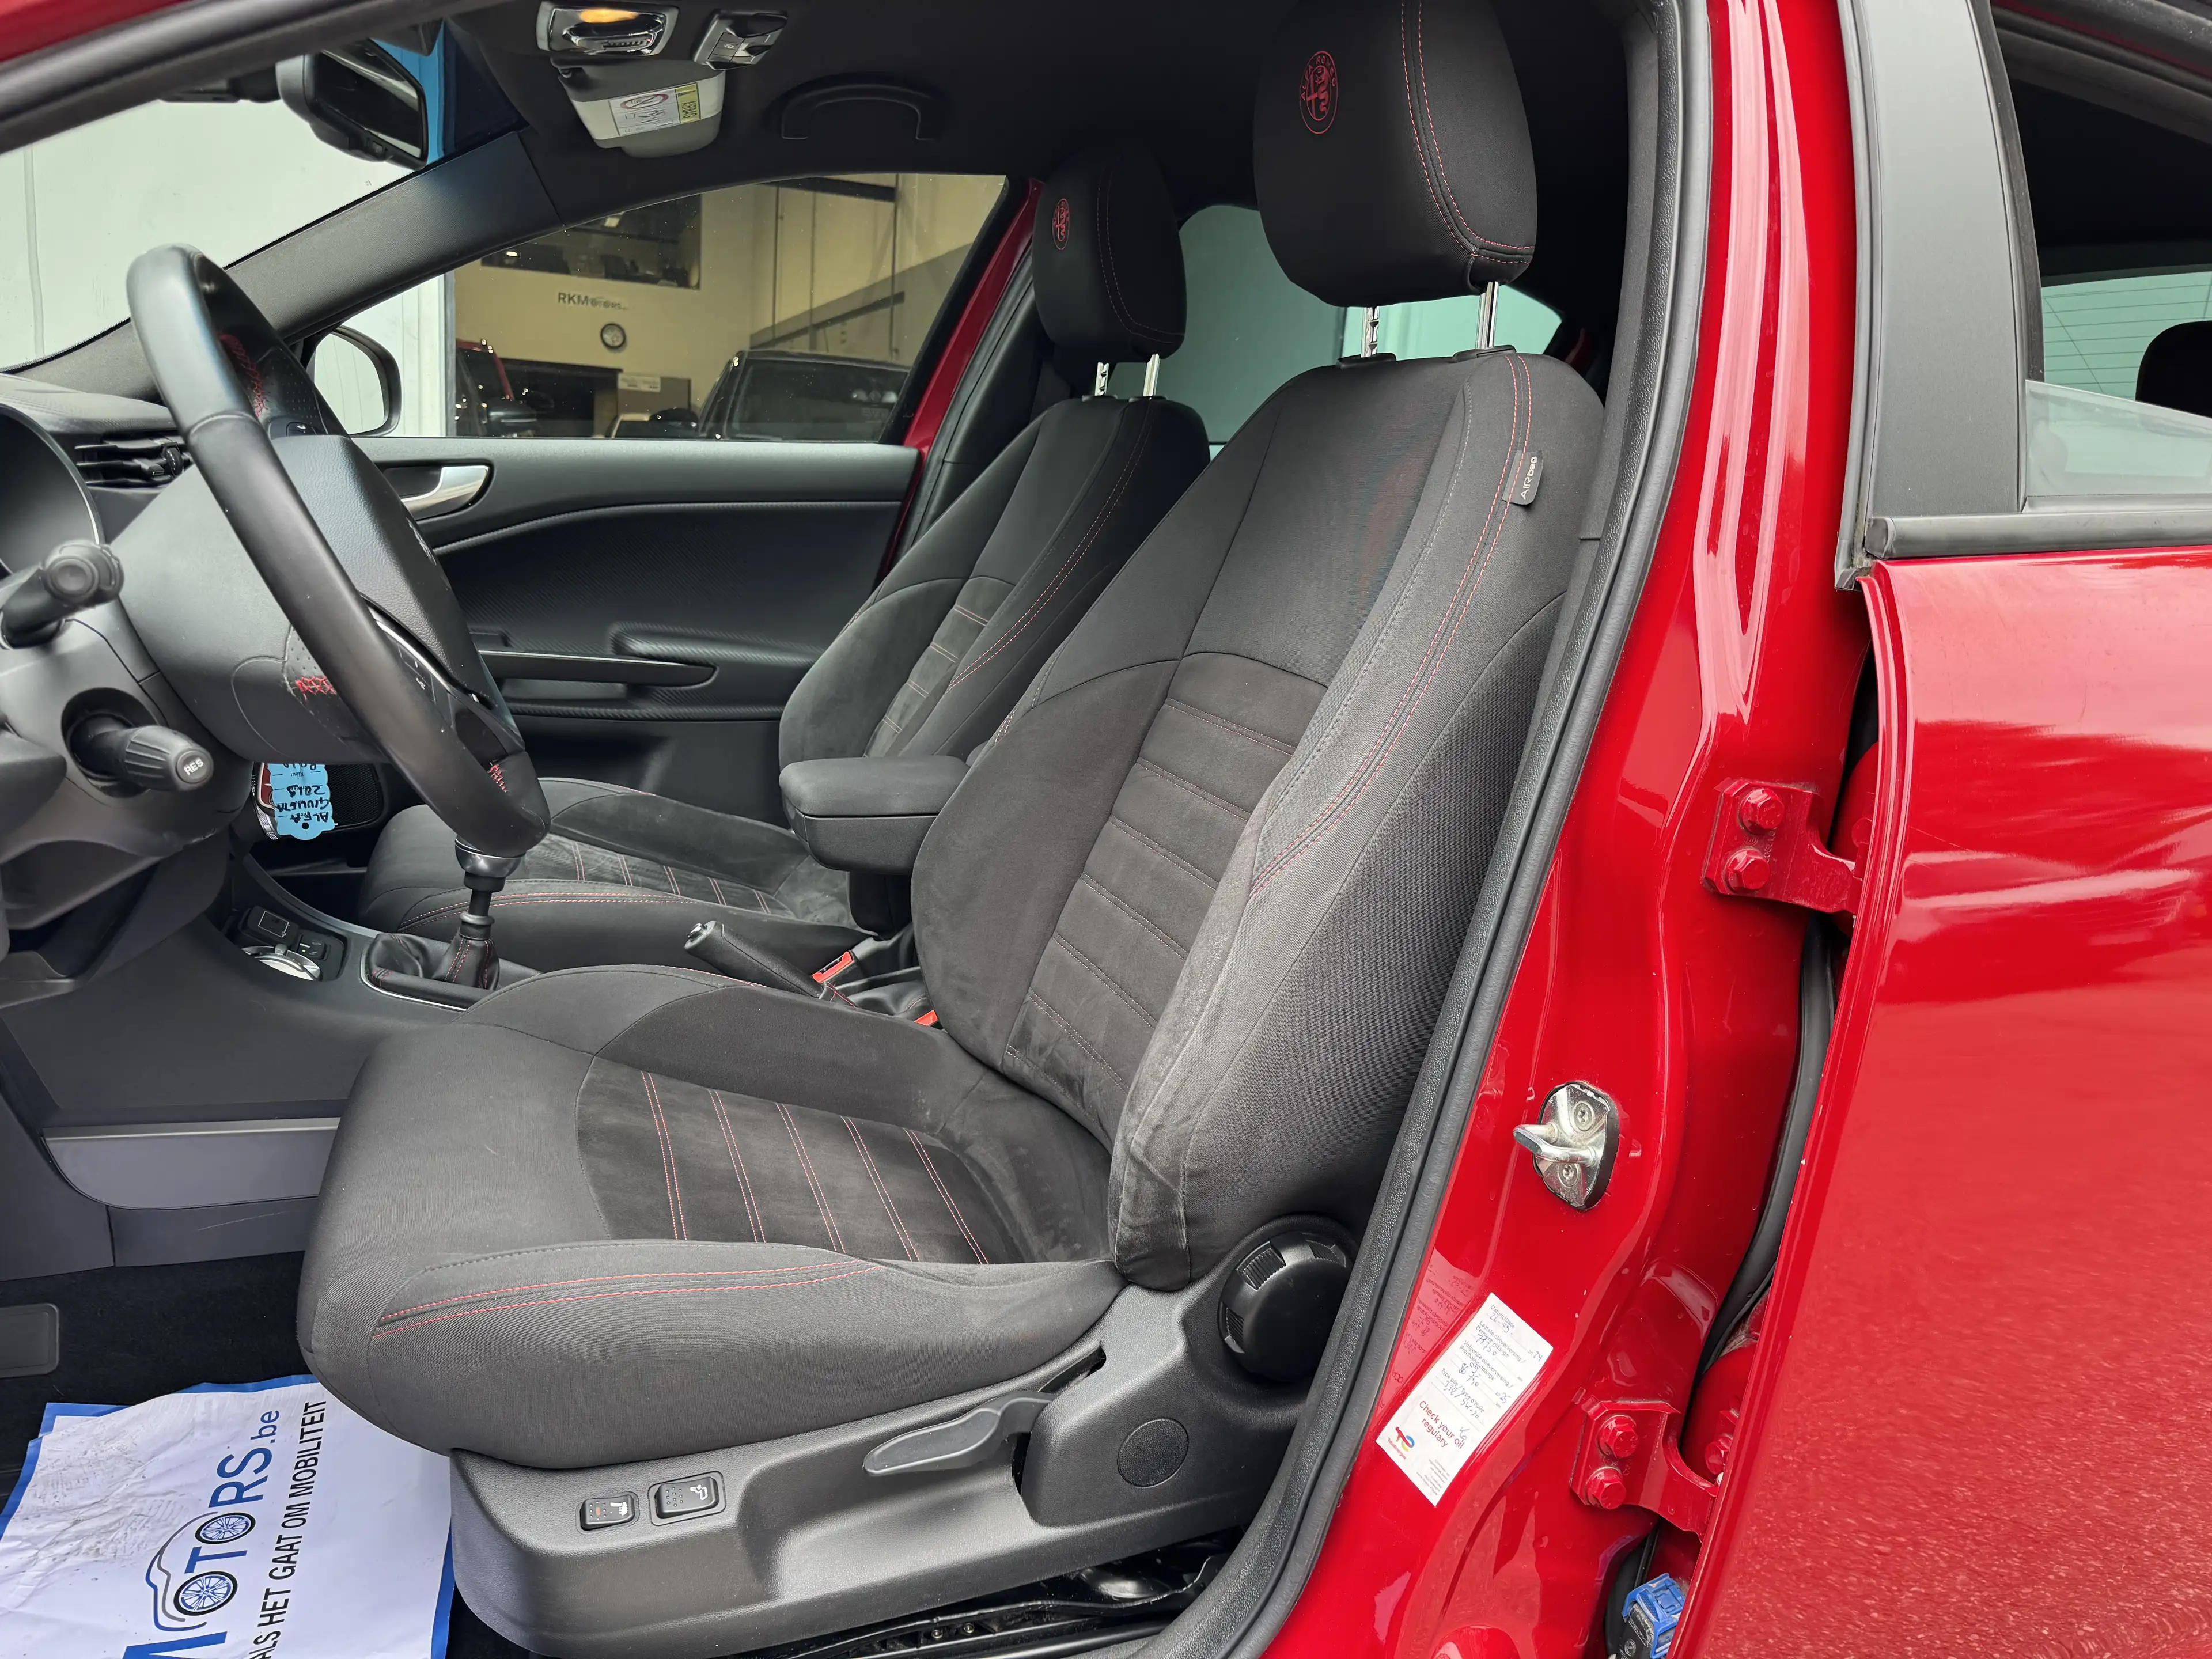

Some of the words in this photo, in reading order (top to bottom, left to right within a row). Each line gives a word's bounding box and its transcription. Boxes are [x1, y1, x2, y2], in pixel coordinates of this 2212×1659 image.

[184, 757, 204, 775] RES
[1419, 1400, 1440, 1424] Check
[1437, 1422, 1455, 1438] your
[1454, 1438, 1465, 1449] oil
[1421, 1418, 1448, 1448] regulary
[288, 1400, 327, 1499] MOBILITEIT
[281, 1501, 311, 1528] OM
[268, 1534, 304, 1580] GAAT
[257, 1588, 291, 1627] HET
